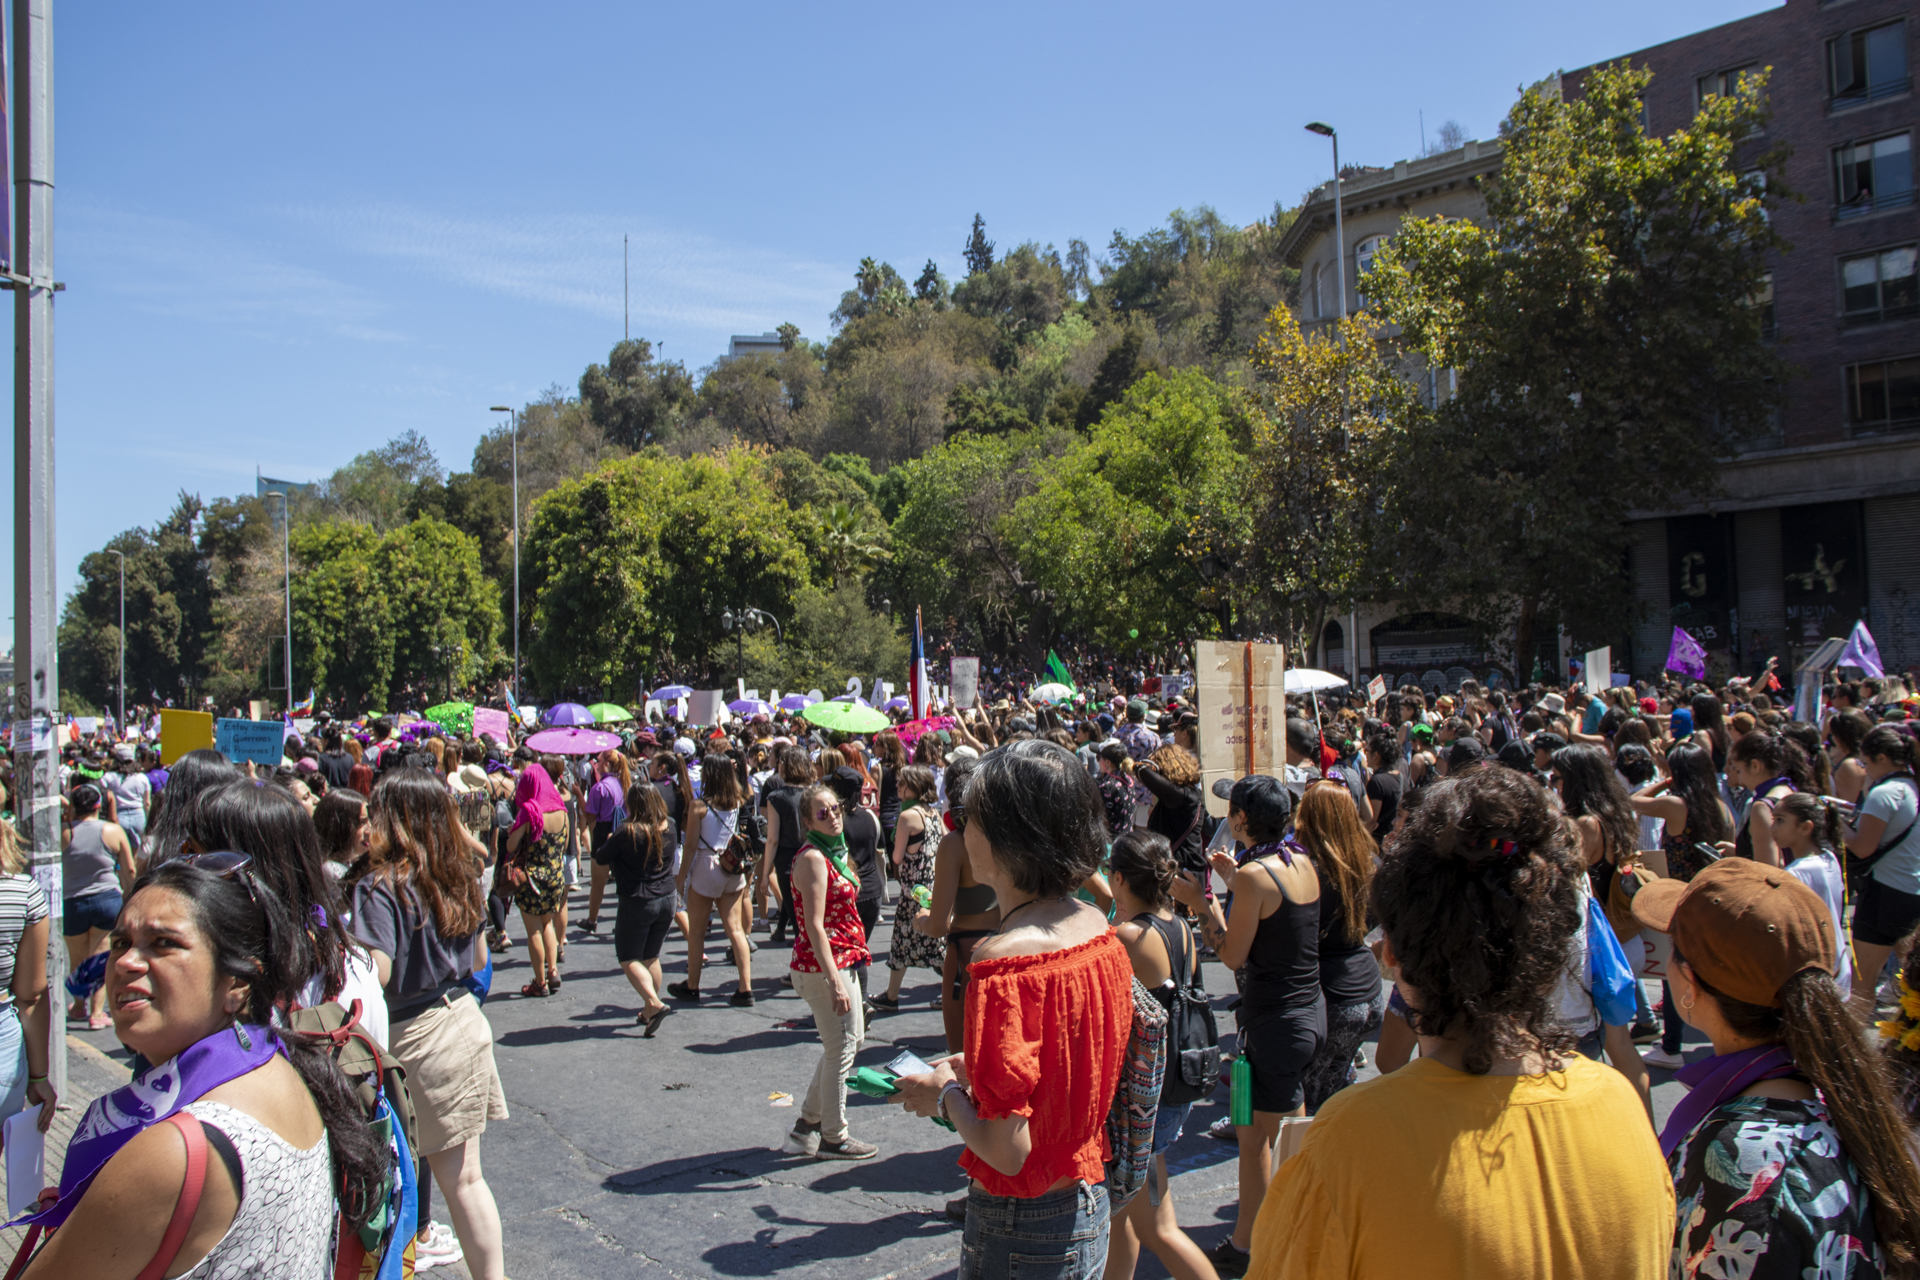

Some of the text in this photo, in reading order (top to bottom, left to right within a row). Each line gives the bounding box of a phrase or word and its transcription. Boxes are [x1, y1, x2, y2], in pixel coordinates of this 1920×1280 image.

[224, 721, 280, 734] Estoy criando
[221, 745, 231, 754] No
